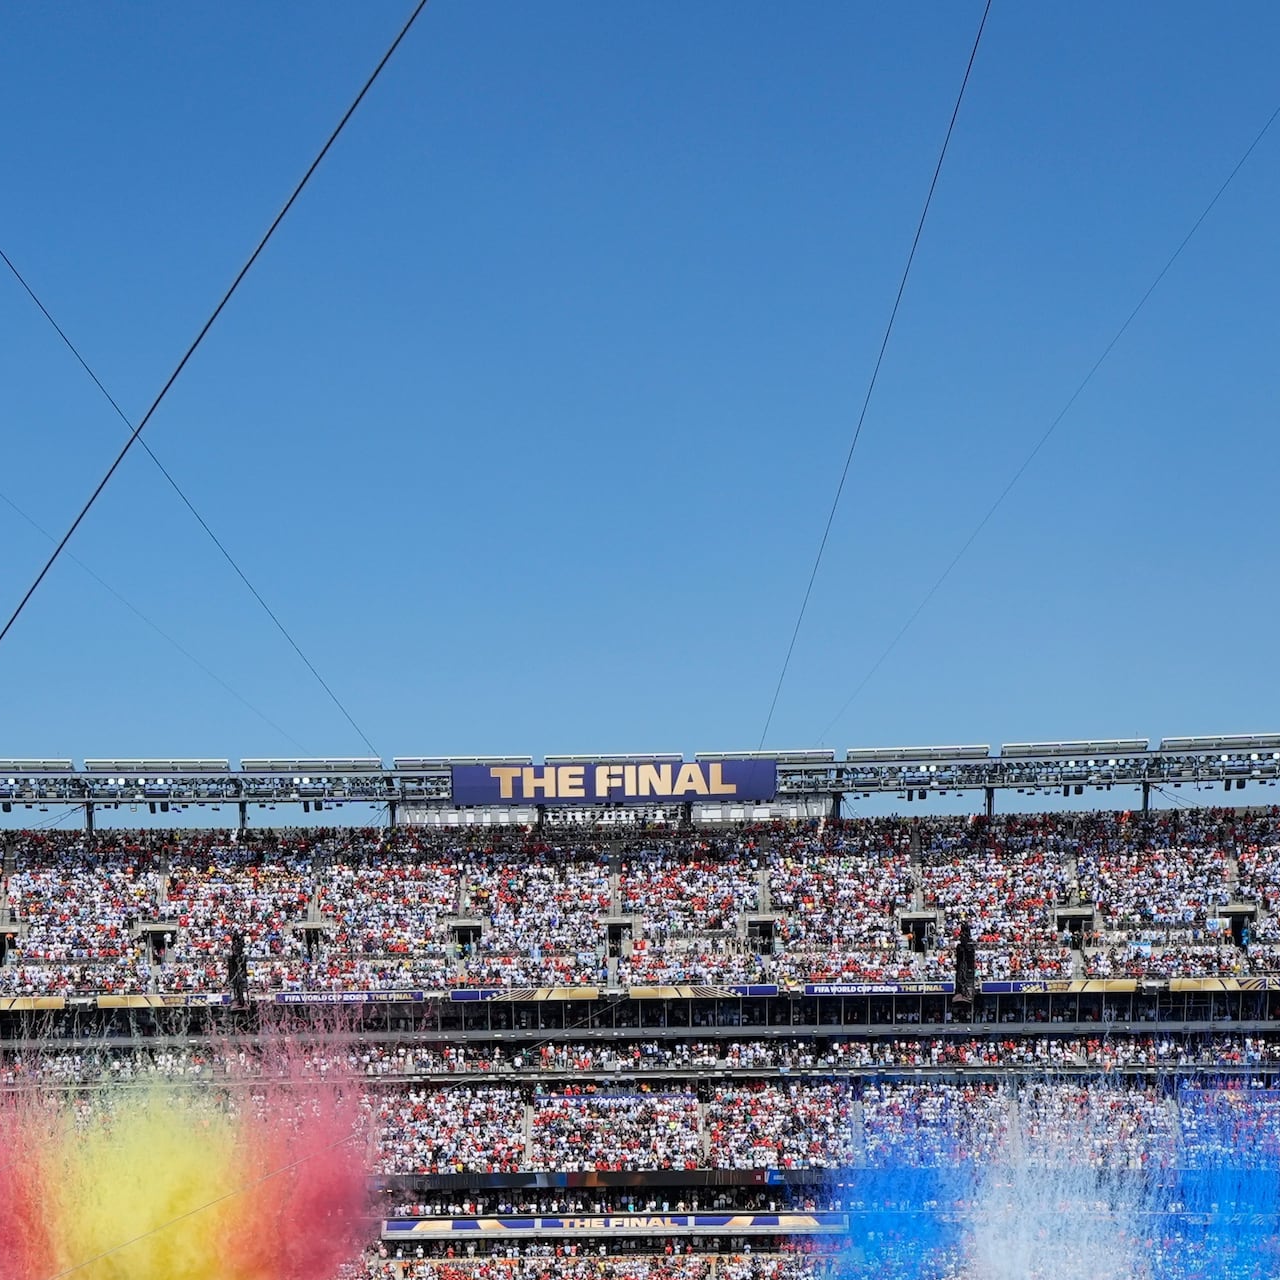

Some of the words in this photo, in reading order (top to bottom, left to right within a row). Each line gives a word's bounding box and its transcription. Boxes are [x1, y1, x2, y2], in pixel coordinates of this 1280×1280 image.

[490, 765, 586, 798] THE
[595, 763, 737, 797] FINAL
[832, 985, 857, 993] WORLD
[900, 984, 916, 992] THE
[917, 984, 944, 992] FINAL
[285, 994, 302, 1002] FIFA
[371, 993, 388, 1001] THE
[389, 993, 414, 1001] FINAL
[559, 1218, 604, 1228] THE
[609, 1217, 679, 1228] FINAL
